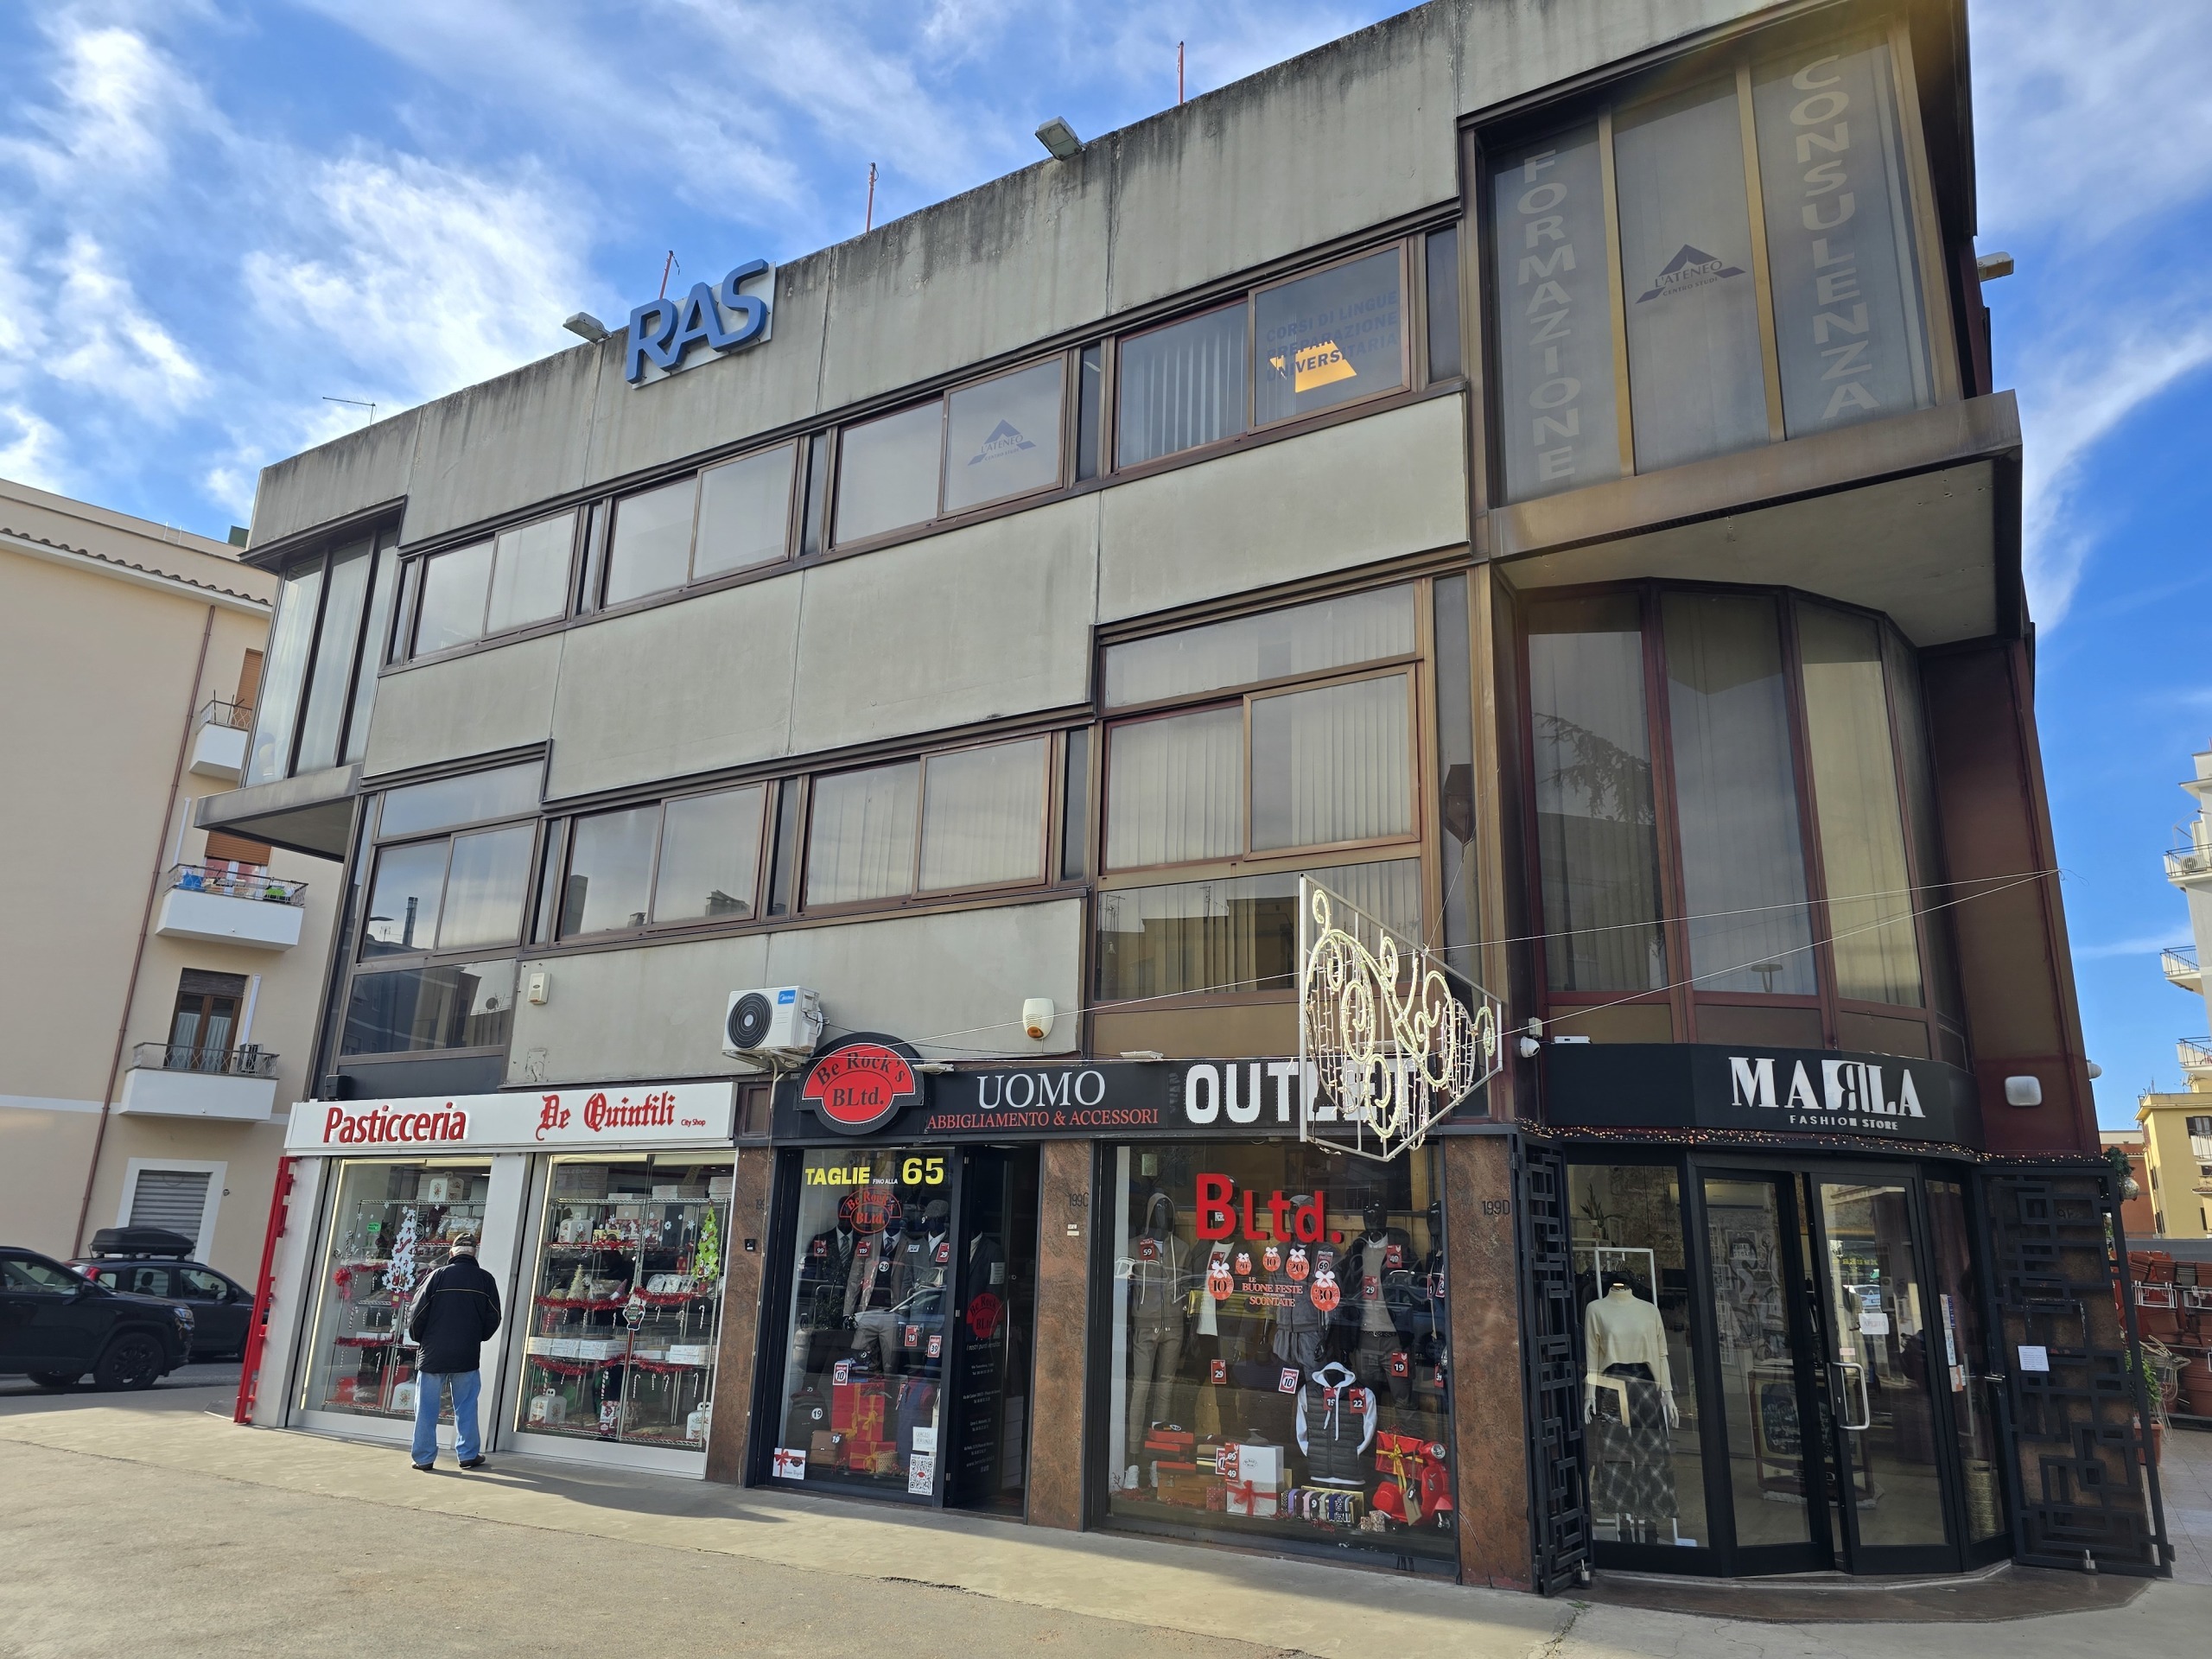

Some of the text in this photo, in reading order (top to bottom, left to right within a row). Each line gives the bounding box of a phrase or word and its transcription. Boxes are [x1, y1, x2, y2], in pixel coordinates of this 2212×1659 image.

[1789, 54, 1881, 420] CONSULENZA
[1655, 260, 1723, 289] L'ATENEO
[1662, 277, 1718, 296] CENTRO STUDI
[625, 258, 769, 385] RAS
[1267, 290, 1396, 342] CORSI DI LINGUE
[1517, 150, 1582, 482] FORMAZIONE
[1267, 310, 1397, 361] PREPARAZIONE
[1267, 334, 1397, 382] UNIVERSITARIA
[981, 435, 1024, 453] L'ATENEO
[816, 1052, 906, 1086] Be Rock's
[832, 1086, 884, 1107] BLtd.
[976, 1070, 1106, 1109] UOMO
[322, 1101, 467, 1143] Pasticceria
[535, 1094, 571, 1141] De
[583, 1090, 676, 1133] Quintili
[692, 1118, 706, 1127] Shop
[926, 1109, 1159, 1129] ABBIGLIAMENTO & ACCESSORI
[1789, 1115, 1898, 1130] FASHION STORE
[804, 1166, 871, 1185] TAGLIE
[902, 1157, 944, 1185] 65
[1069, 1192, 1089, 1207] 199C
[1482, 1199, 1510, 1216] 199D
[1266, 1258, 1276, 1267] 10
[1289, 1263, 1304, 1272] 20
[1319, 1262, 1328, 1270] 69
[1213, 1280, 1227, 1292] 10
[1242, 1282, 1303, 1294] BUONE FESTE
[1314, 1288, 1333, 1300] 30
[1249, 1296, 1296, 1307] SCONTATE
[836, 1371, 844, 1380] 10
[1214, 1370, 1224, 1378] 29
[1284, 1377, 1294, 1388] 10
[813, 1409, 822, 1418] 19
[1311, 1499, 1318, 1508] 9
